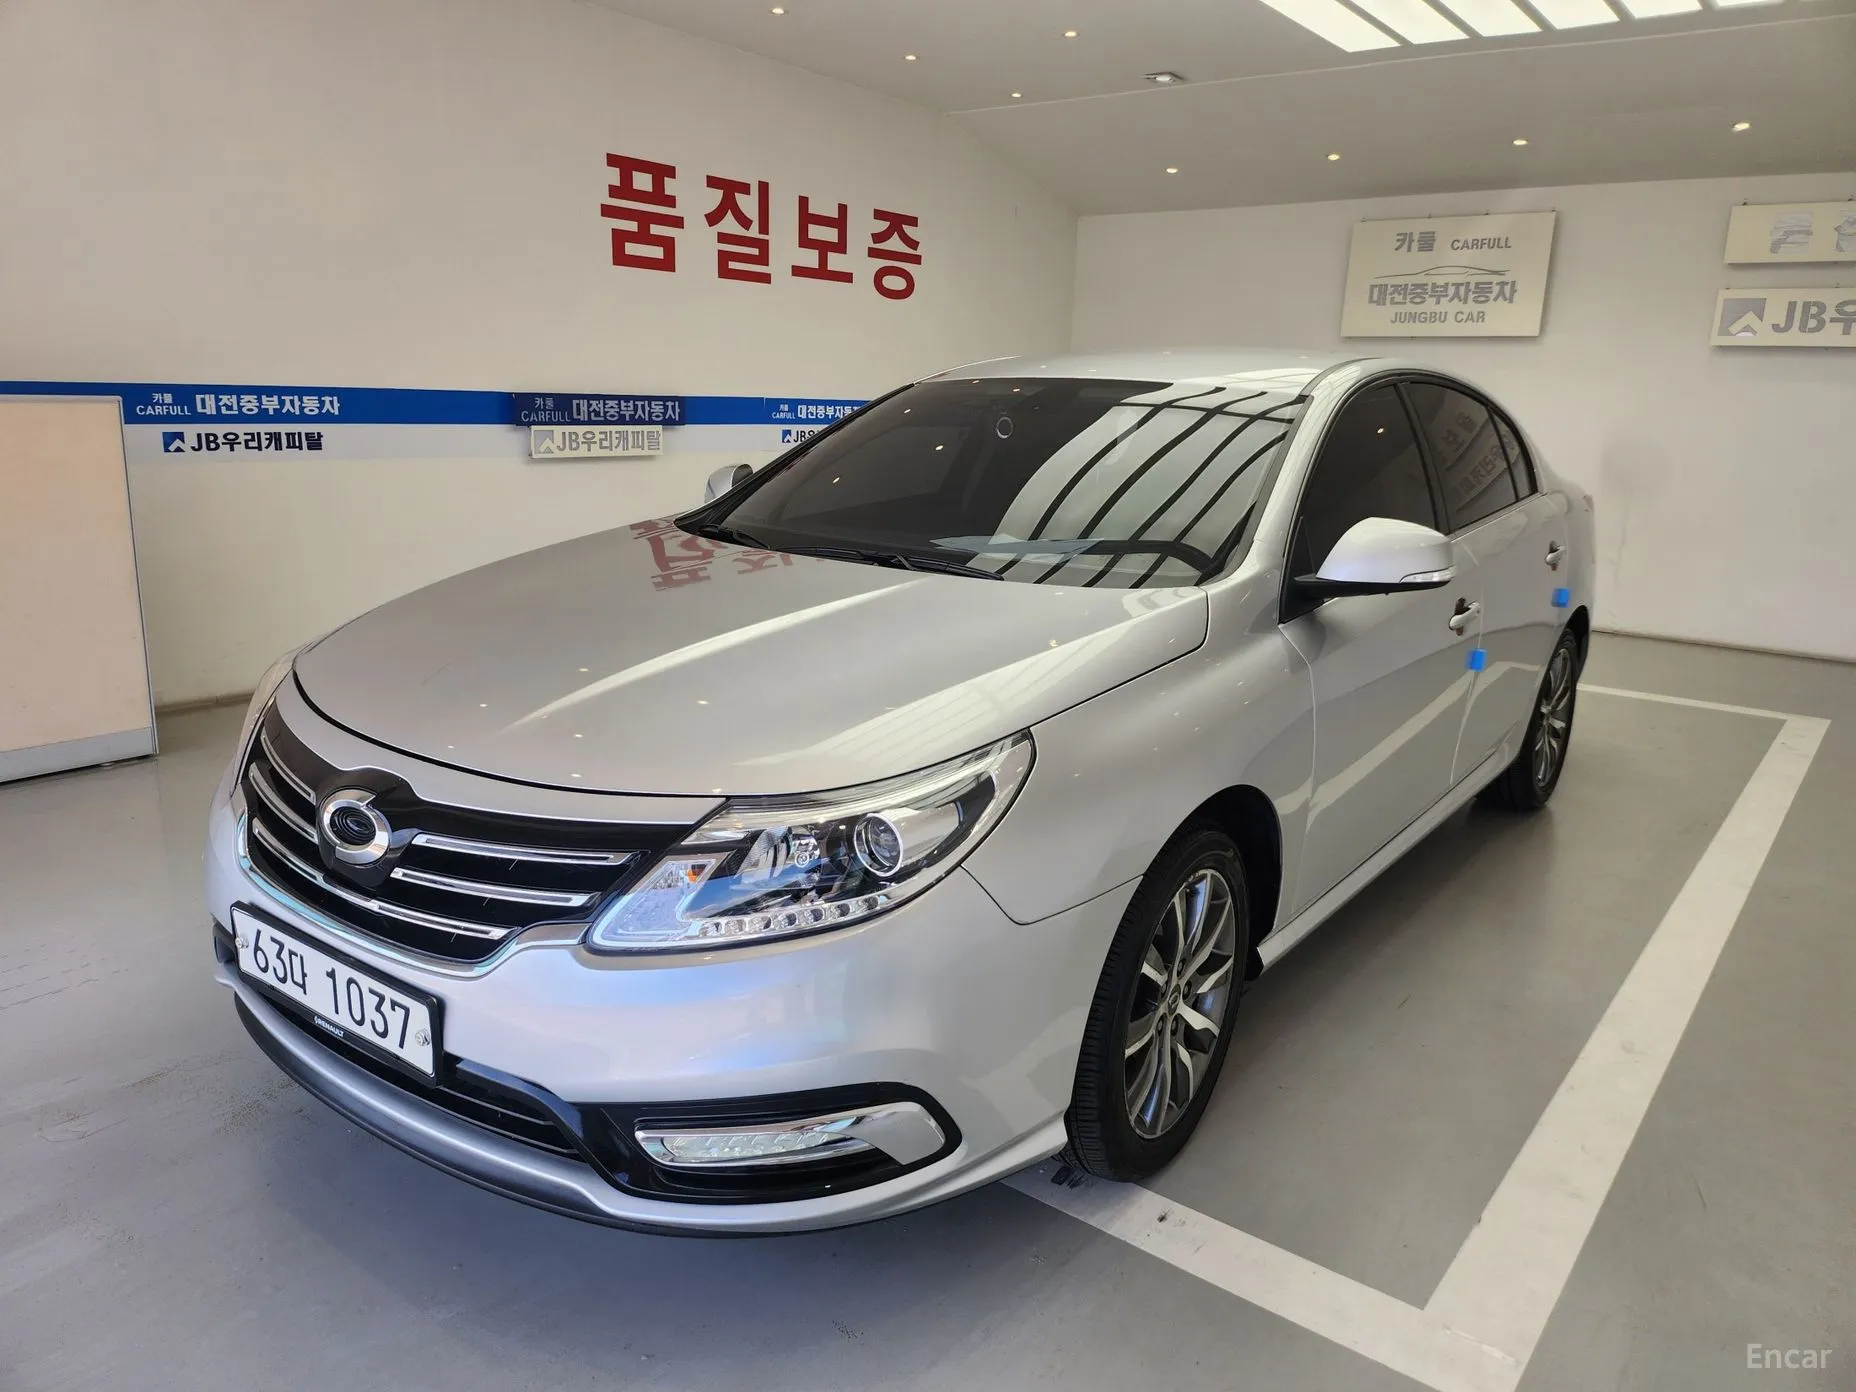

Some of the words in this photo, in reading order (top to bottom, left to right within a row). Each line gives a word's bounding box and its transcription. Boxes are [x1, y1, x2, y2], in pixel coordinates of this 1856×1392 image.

[600, 152, 922, 301] 품질보증
[1450, 236, 1512, 251] CARFULL
[1367, 280, 1518, 306] 대전중부자동차
[1390, 311, 1448, 324] JUNGBU
[1454, 310, 1486, 323] CAR
[136, 405, 192, 415] CARFULL
[195, 394, 341, 416] 대전중부자동차
[572, 399, 681, 421] 대전중부자동차
[521, 410, 571, 423] CARFULL
[190, 431, 324, 452] JB우리캐피탈
[556, 430, 662, 452] JB우리캐피탈
[253, 928, 308, 996] 63마
[325, 966, 410, 1050] 1037
